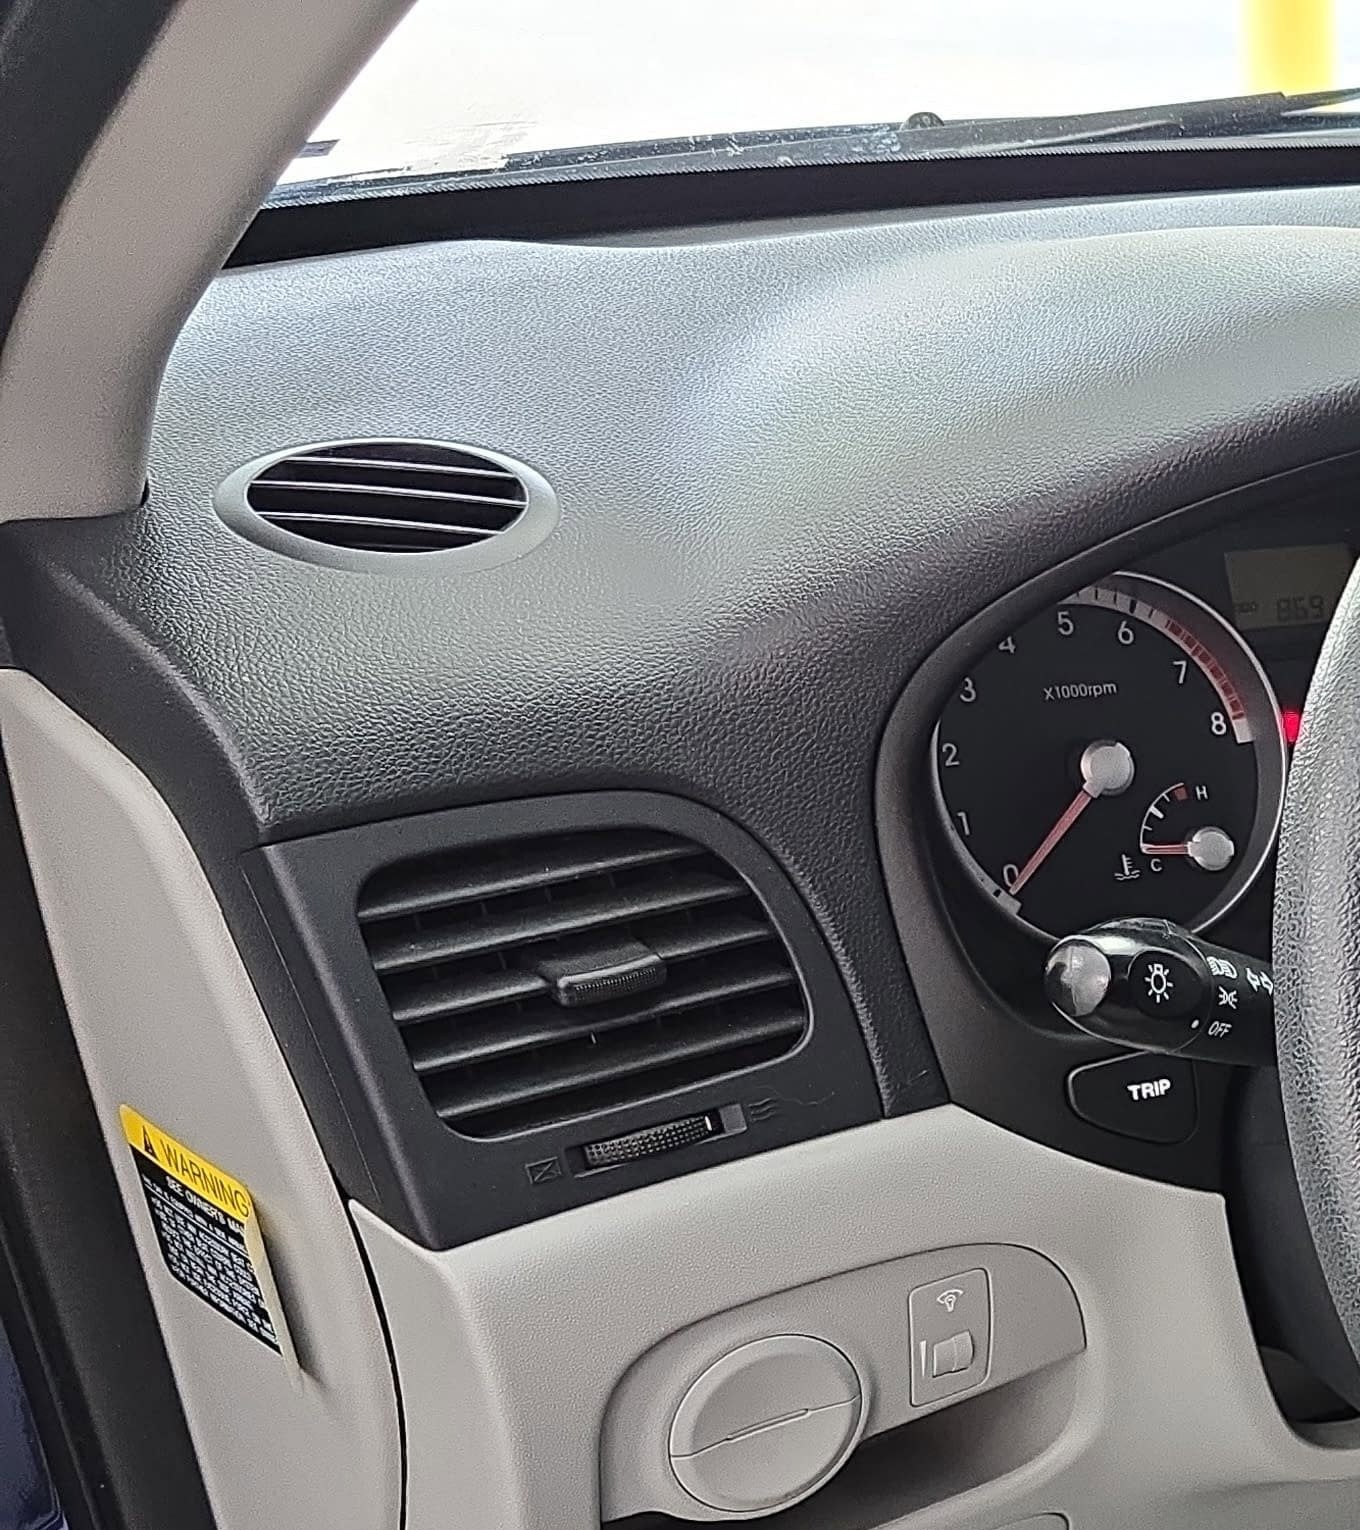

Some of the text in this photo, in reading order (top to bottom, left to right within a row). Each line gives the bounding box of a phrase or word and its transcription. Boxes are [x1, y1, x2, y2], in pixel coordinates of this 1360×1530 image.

[1056, 611, 1075, 635] 5
[1117, 622, 1135, 645] 6
[998, 636, 1016, 653] 4
[1172, 660, 1187, 684] 7
[959, 677, 976, 702] 3
[1044, 682, 1117, 701] X1000rpm
[1211, 711, 1227, 735] 8
[942, 744, 960, 766] 2
[1196, 786, 1208, 800] H
[957, 812, 970, 836] 1
[1003, 864, 1020, 888] 0
[1150, 859, 1162, 872] C
[1207, 1020, 1232, 1038] OFF
[1126, 1078, 1171, 1101] TRIP
[160, 1139, 250, 1218] WARNING
